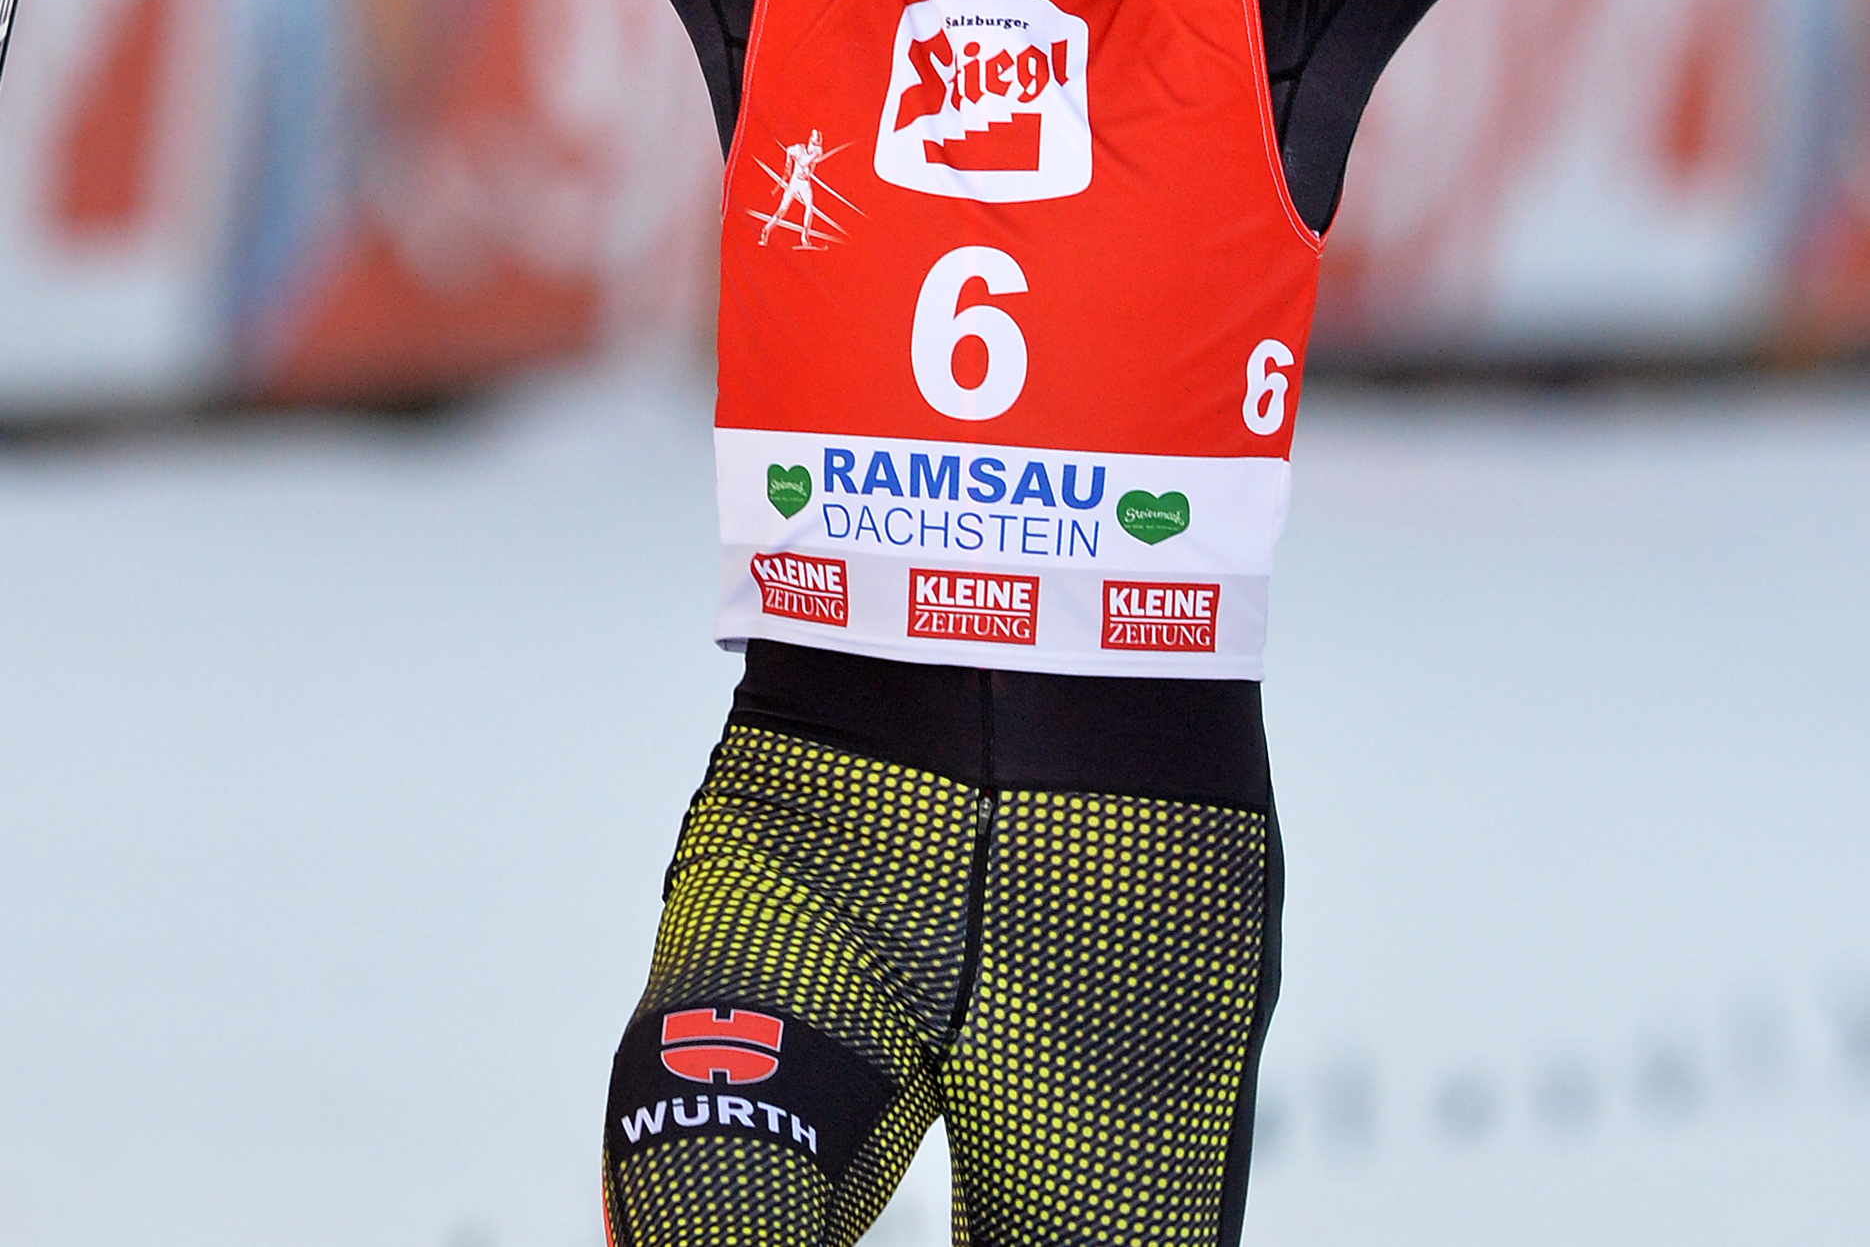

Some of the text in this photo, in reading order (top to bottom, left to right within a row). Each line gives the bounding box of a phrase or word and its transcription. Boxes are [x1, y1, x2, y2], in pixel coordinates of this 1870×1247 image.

[945, 15, 1030, 30] Salzburger
[893, 29, 1071, 133] Stiegl
[911, 245, 1029, 421] 6
[1243, 339, 1295, 436] 6
[823, 447, 1107, 510] RAMSAU
[823, 504, 1101, 558] DACHSTEIN
[753, 557, 844, 593] KLEINE
[916, 575, 1033, 611] KLEINE
[765, 587, 845, 620] ZEITUNG
[1109, 587, 1214, 618] KLEINE
[913, 610, 1031, 639] ZEITUNG
[1108, 622, 1211, 646] ZEITUNG
[620, 1095, 817, 1155] WÜRTH
